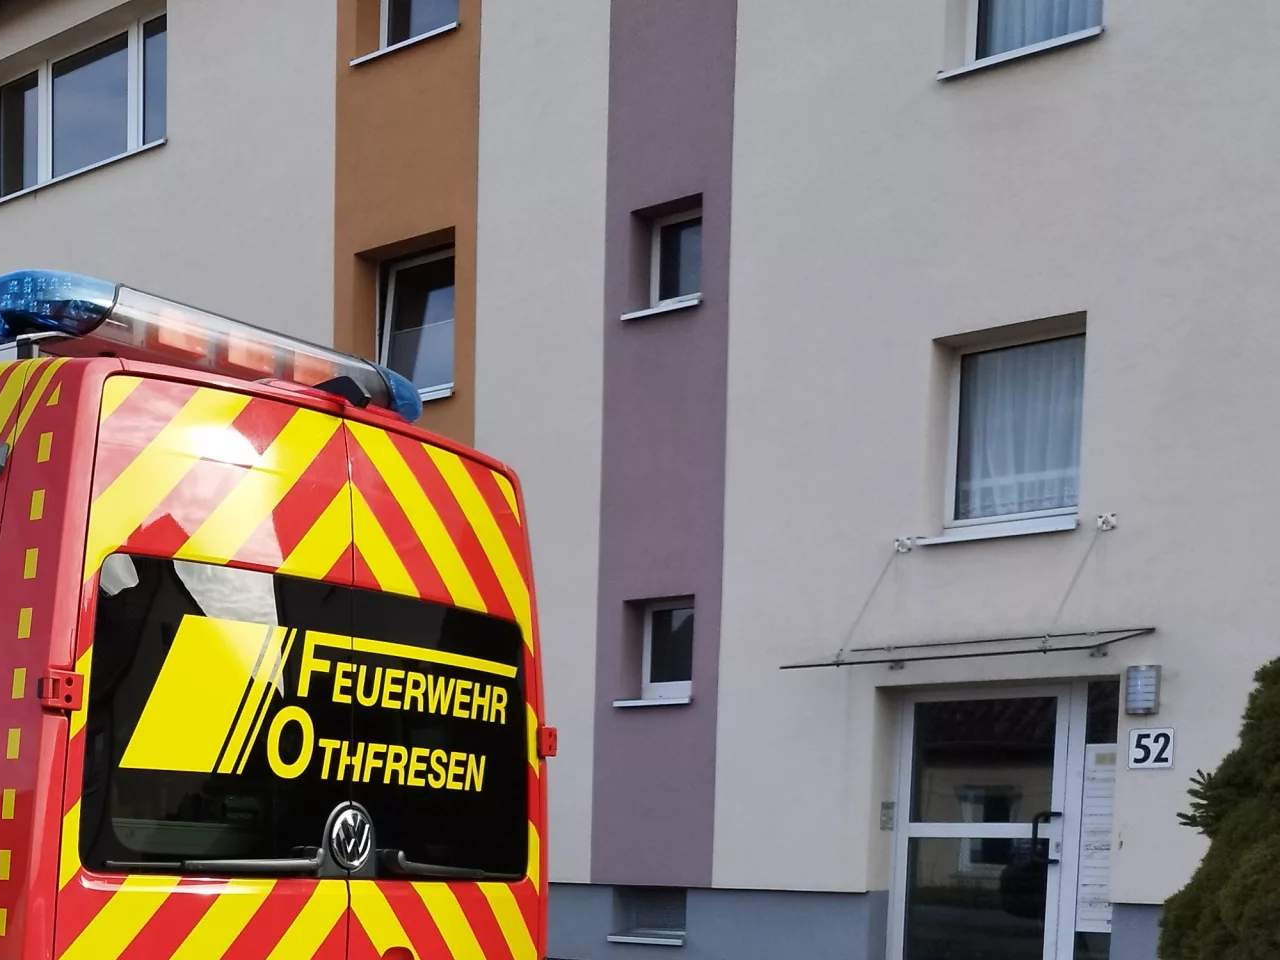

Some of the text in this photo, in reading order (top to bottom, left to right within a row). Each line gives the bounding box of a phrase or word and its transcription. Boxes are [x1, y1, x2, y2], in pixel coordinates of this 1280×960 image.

[297, 630, 510, 725] FEUERWEHR
[266, 705, 488, 793] OTHFRESEN
[1132, 732, 1171, 765] 52
